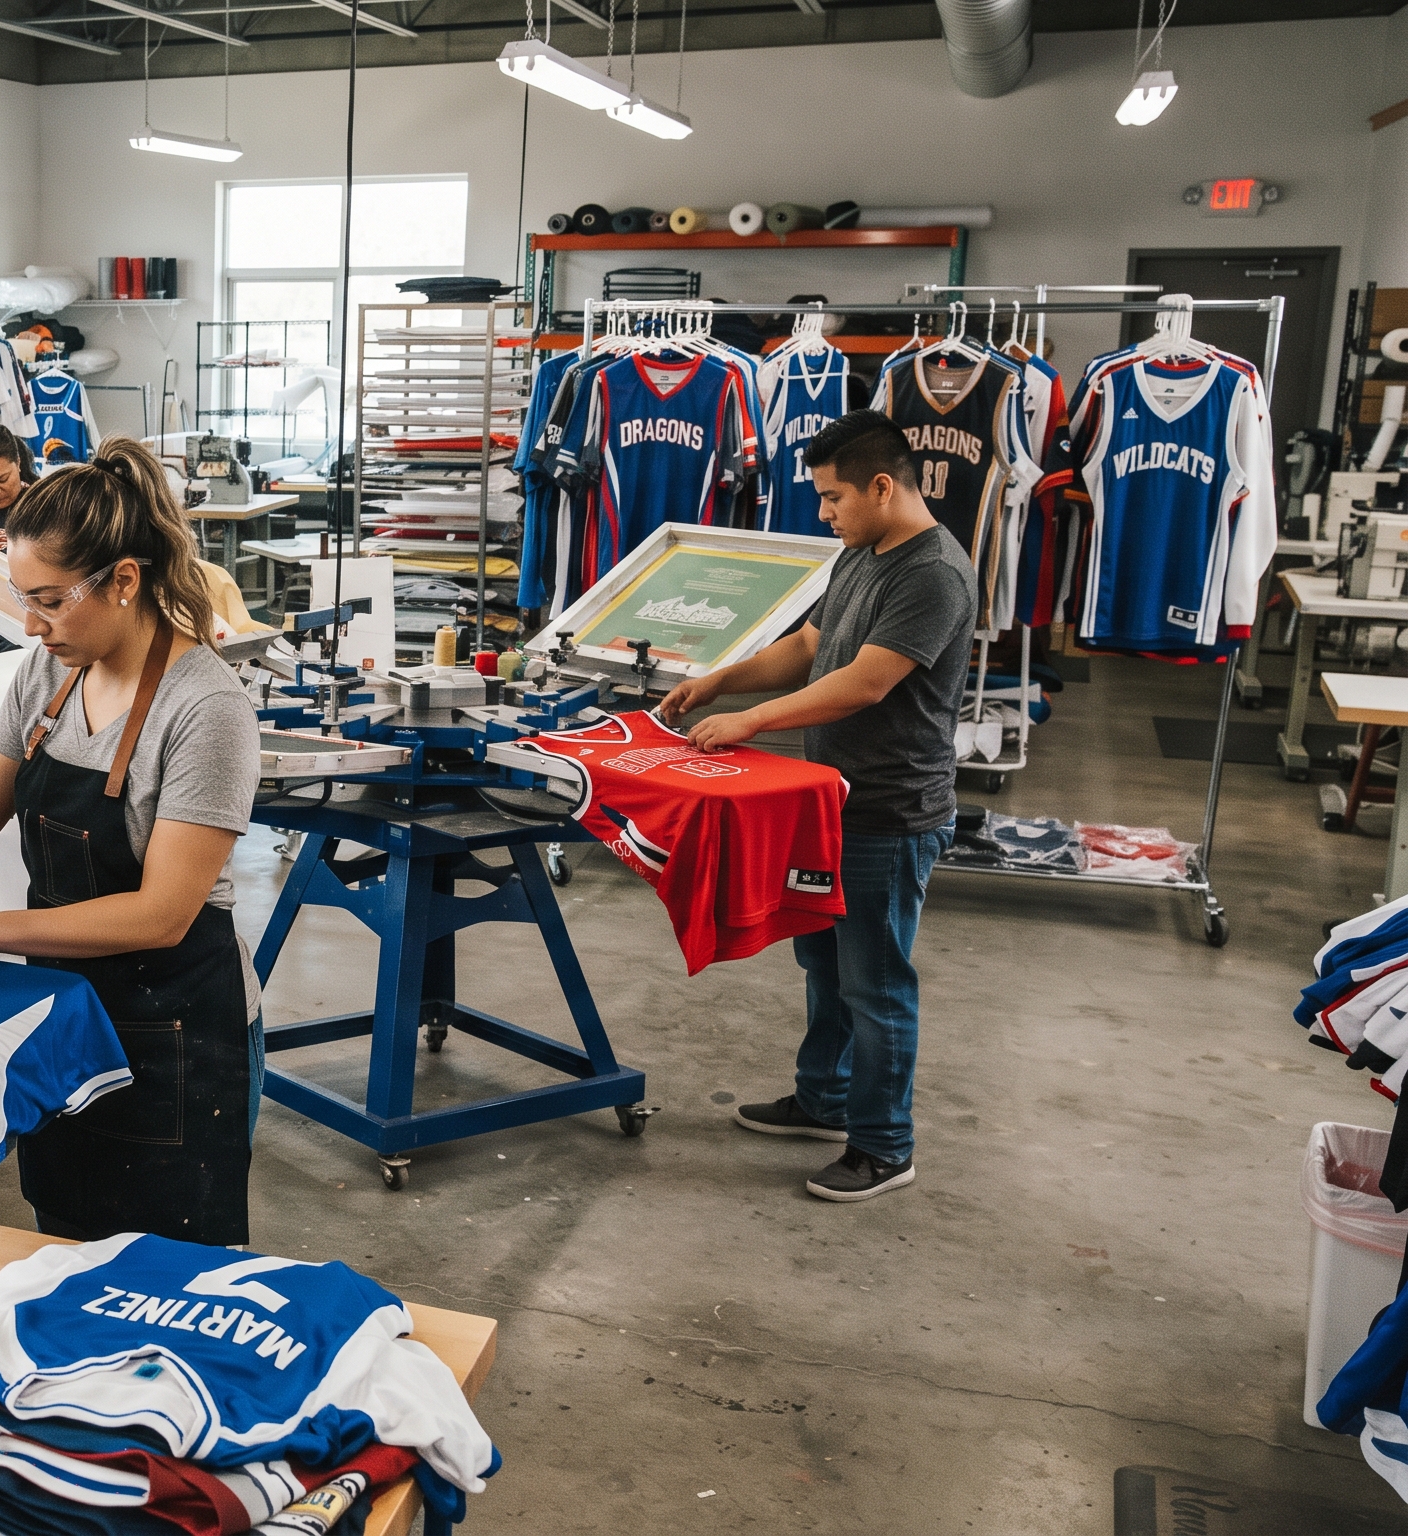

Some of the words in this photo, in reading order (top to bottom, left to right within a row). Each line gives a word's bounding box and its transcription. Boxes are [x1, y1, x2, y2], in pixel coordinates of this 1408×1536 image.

[620, 418, 704, 450] DRAGONS
[785, 413, 835, 447] WILDC
[1113, 442, 1215, 484] WILDCATS
[182, 1256, 330, 1313] 7
[81, 1286, 307, 1371] MARTINEZ
